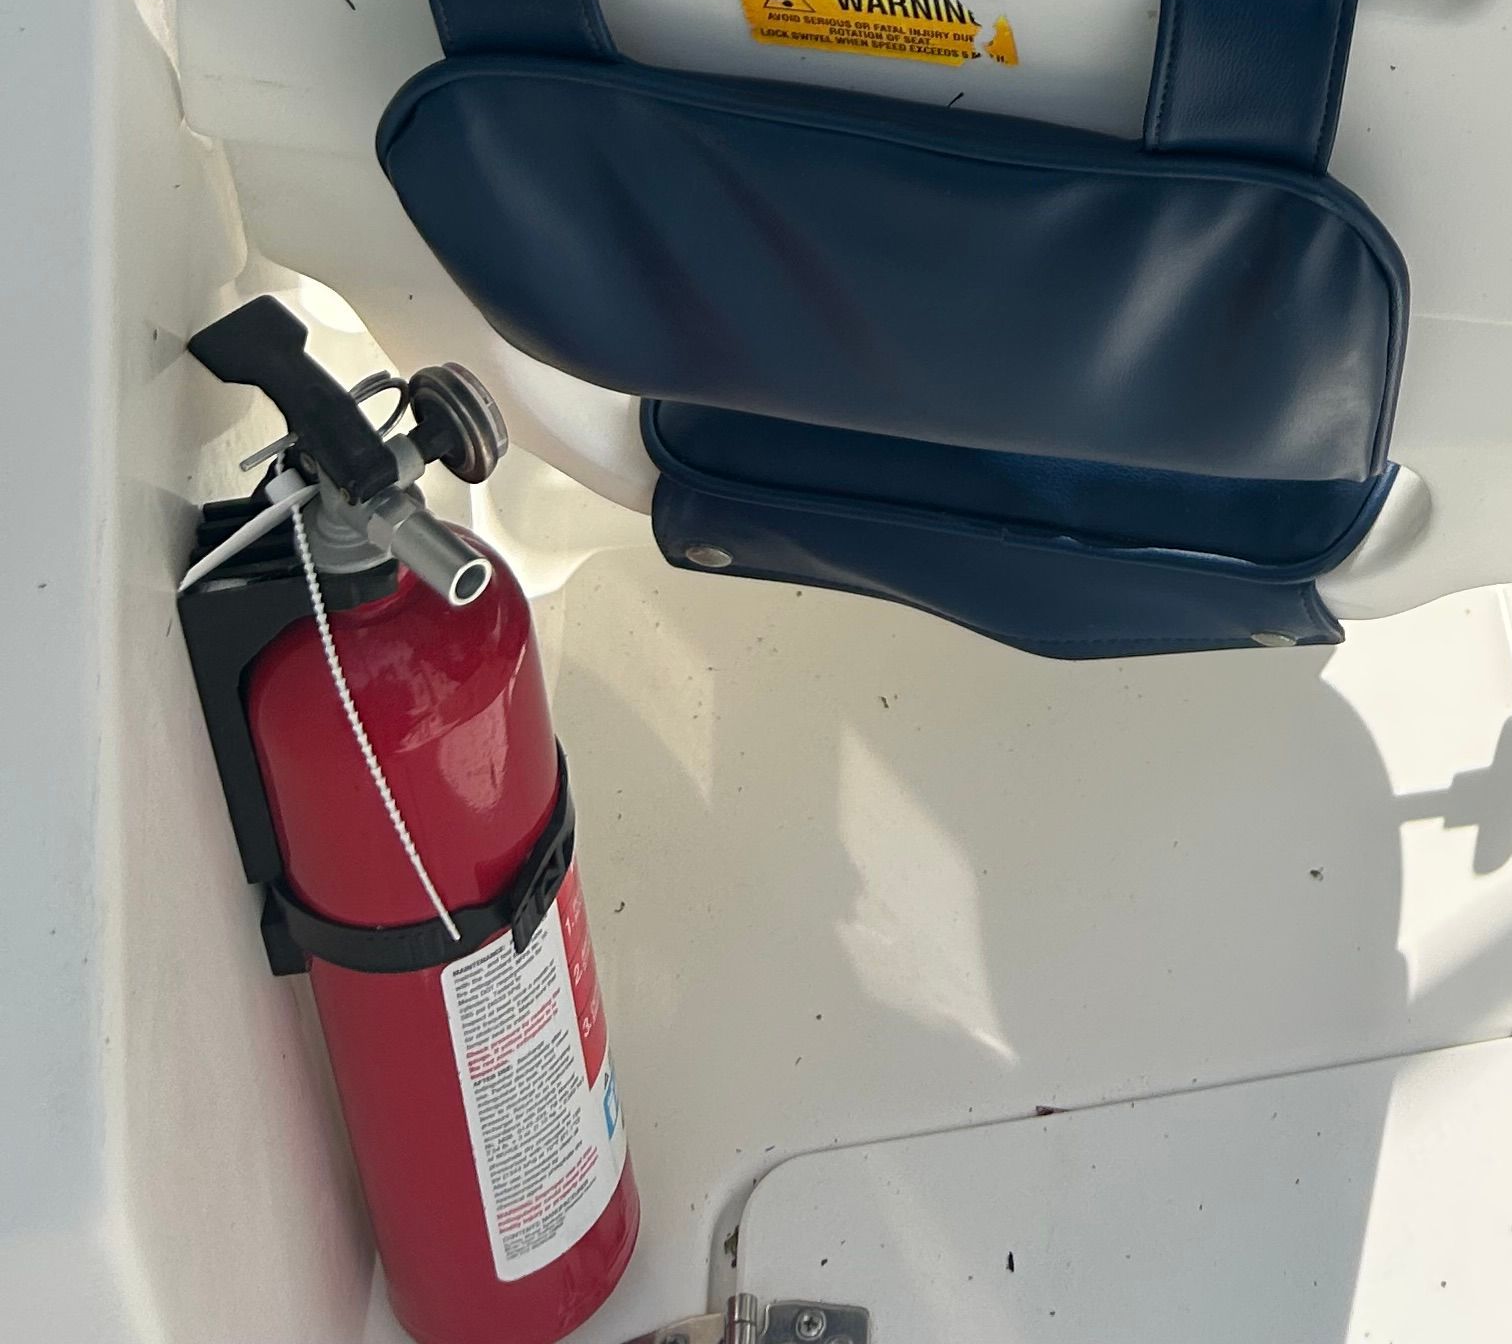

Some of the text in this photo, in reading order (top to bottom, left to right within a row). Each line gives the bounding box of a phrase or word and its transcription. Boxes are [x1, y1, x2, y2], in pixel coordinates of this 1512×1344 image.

[768, 12, 800, 23] AVOID
[804, 15, 852, 28] SERIOUS
[854, 21, 871, 30] OR
[873, 23, 905, 35] FATAL
[909, 27, 950, 40] INJURY
[829, 27, 931, 46] ROTATION OF SEAT
[760, 28, 789, 39] LOCK
[791, 32, 833, 44] SWIVEL
[834, 37, 868, 48] WHEN
[871, 41, 906, 53] SPEED
[909, 45, 960, 58] EXCEEDS
[961, 50, 969, 59] 5
